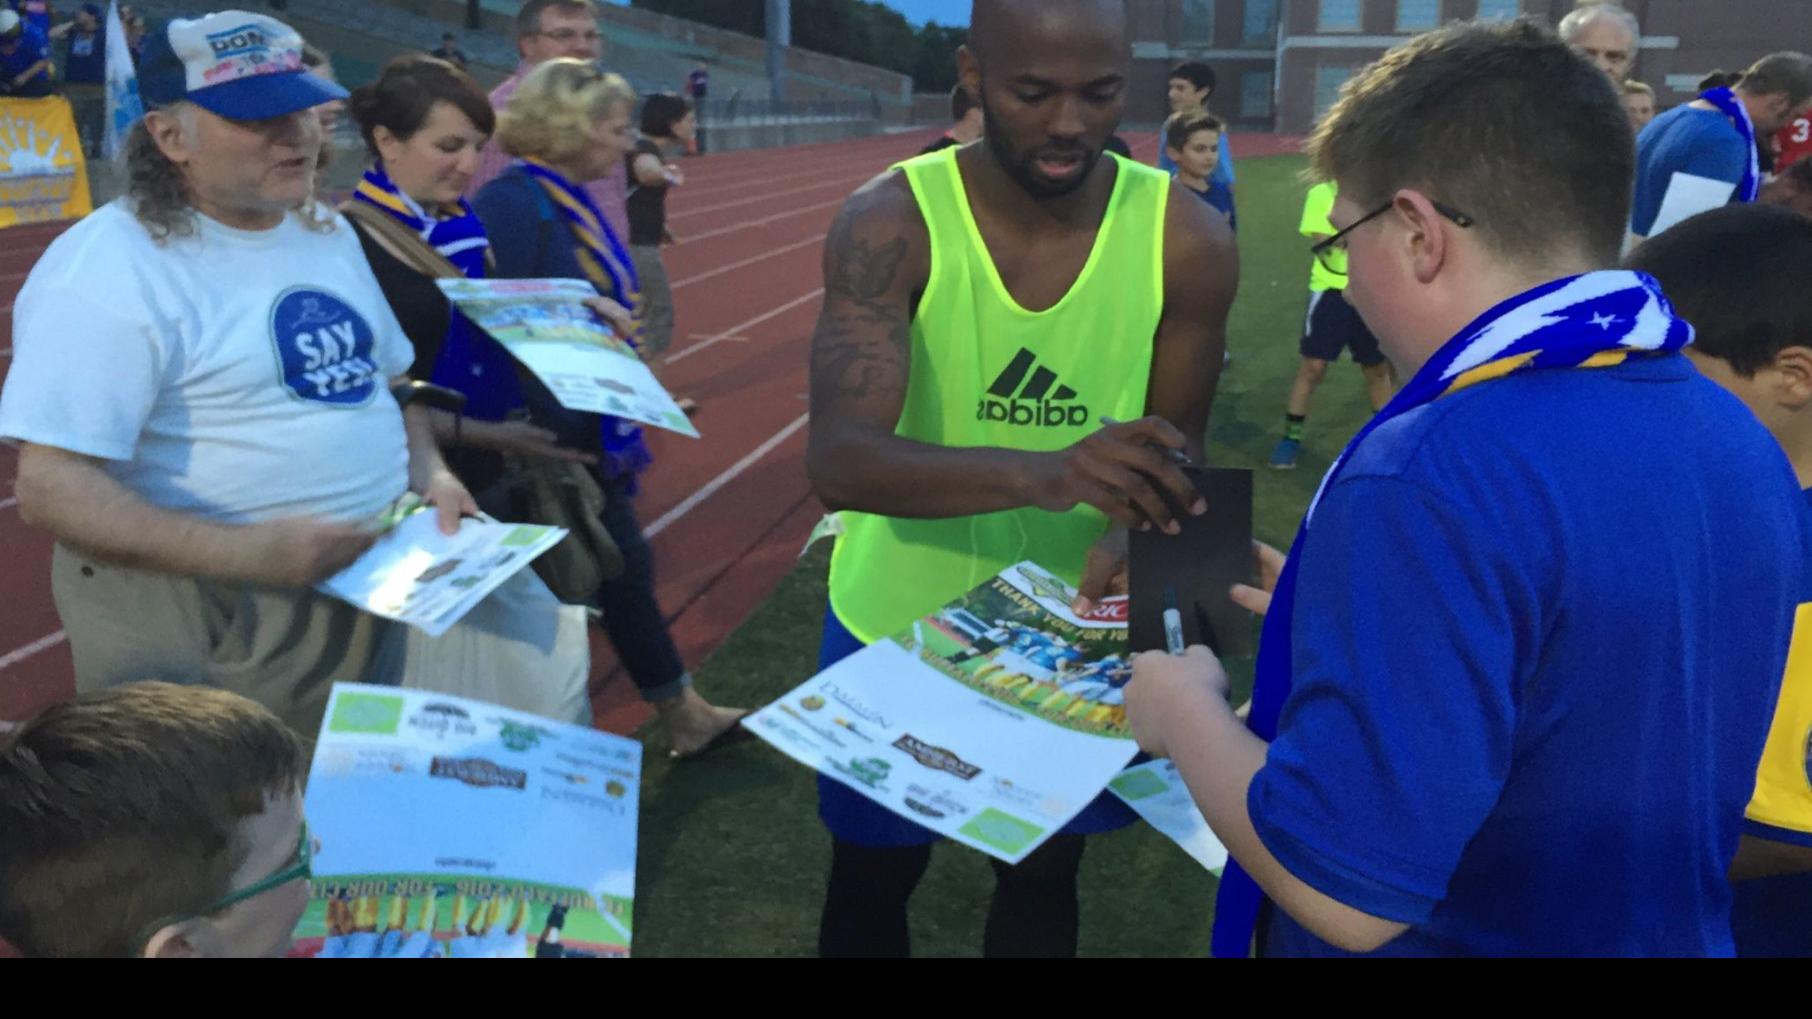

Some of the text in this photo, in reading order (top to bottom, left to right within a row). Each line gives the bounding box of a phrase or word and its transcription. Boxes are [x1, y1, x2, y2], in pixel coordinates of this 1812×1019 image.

[1791, 118, 1810, 143] 3
[295, 320, 356, 370] SAY
[992, 579, 1040, 616] THANK
[1043, 613, 1078, 633] YOU
[346, 878, 390, 898] OUR
[454, 878, 506, 899] 2016
